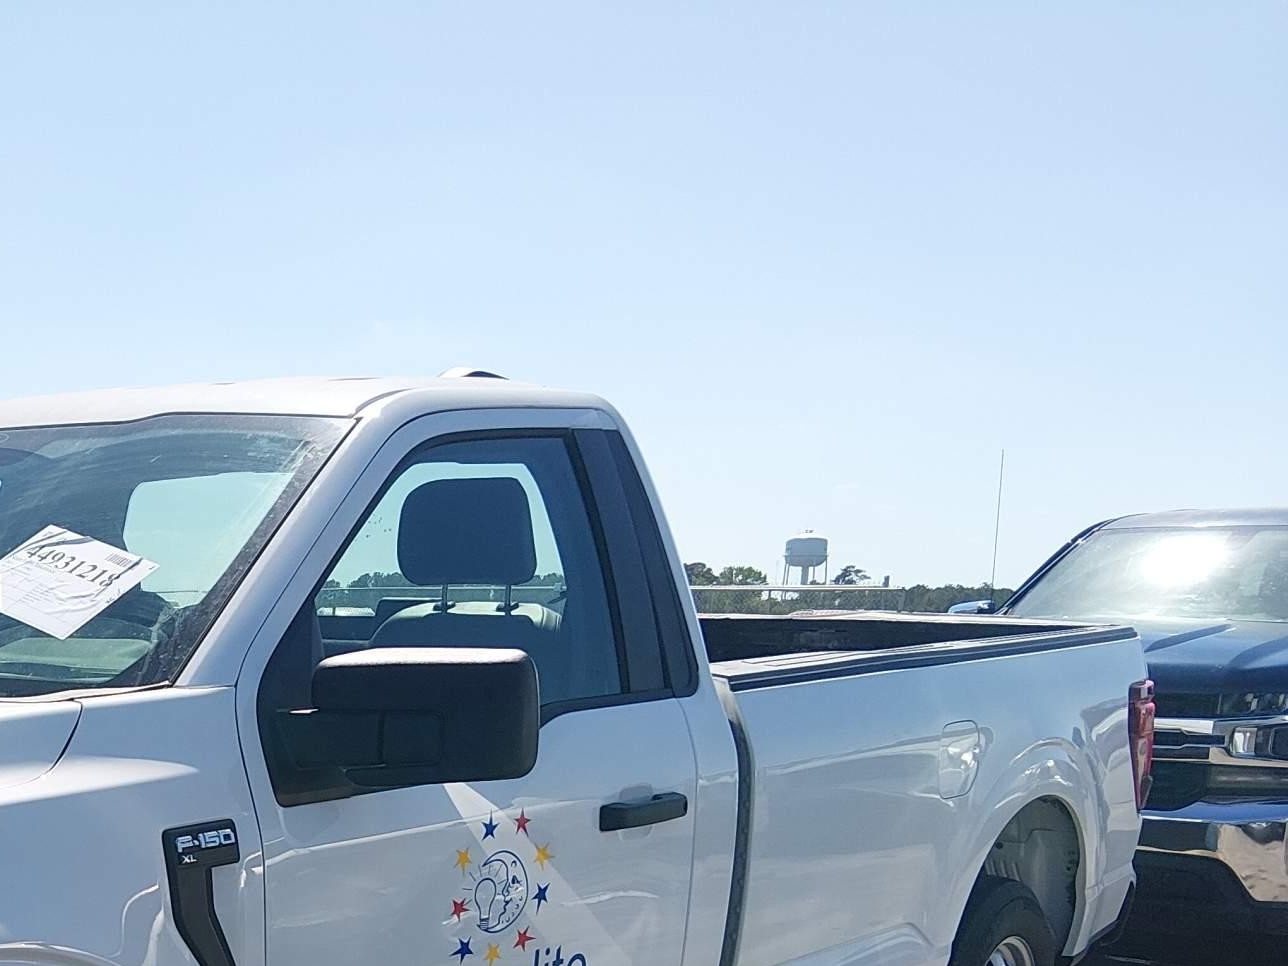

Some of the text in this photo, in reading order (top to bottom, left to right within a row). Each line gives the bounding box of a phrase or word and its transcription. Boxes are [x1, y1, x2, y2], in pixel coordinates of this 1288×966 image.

[26, 545, 121, 587] 44931218
[176, 829, 235, 853] F-150
[182, 854, 197, 864] XL
